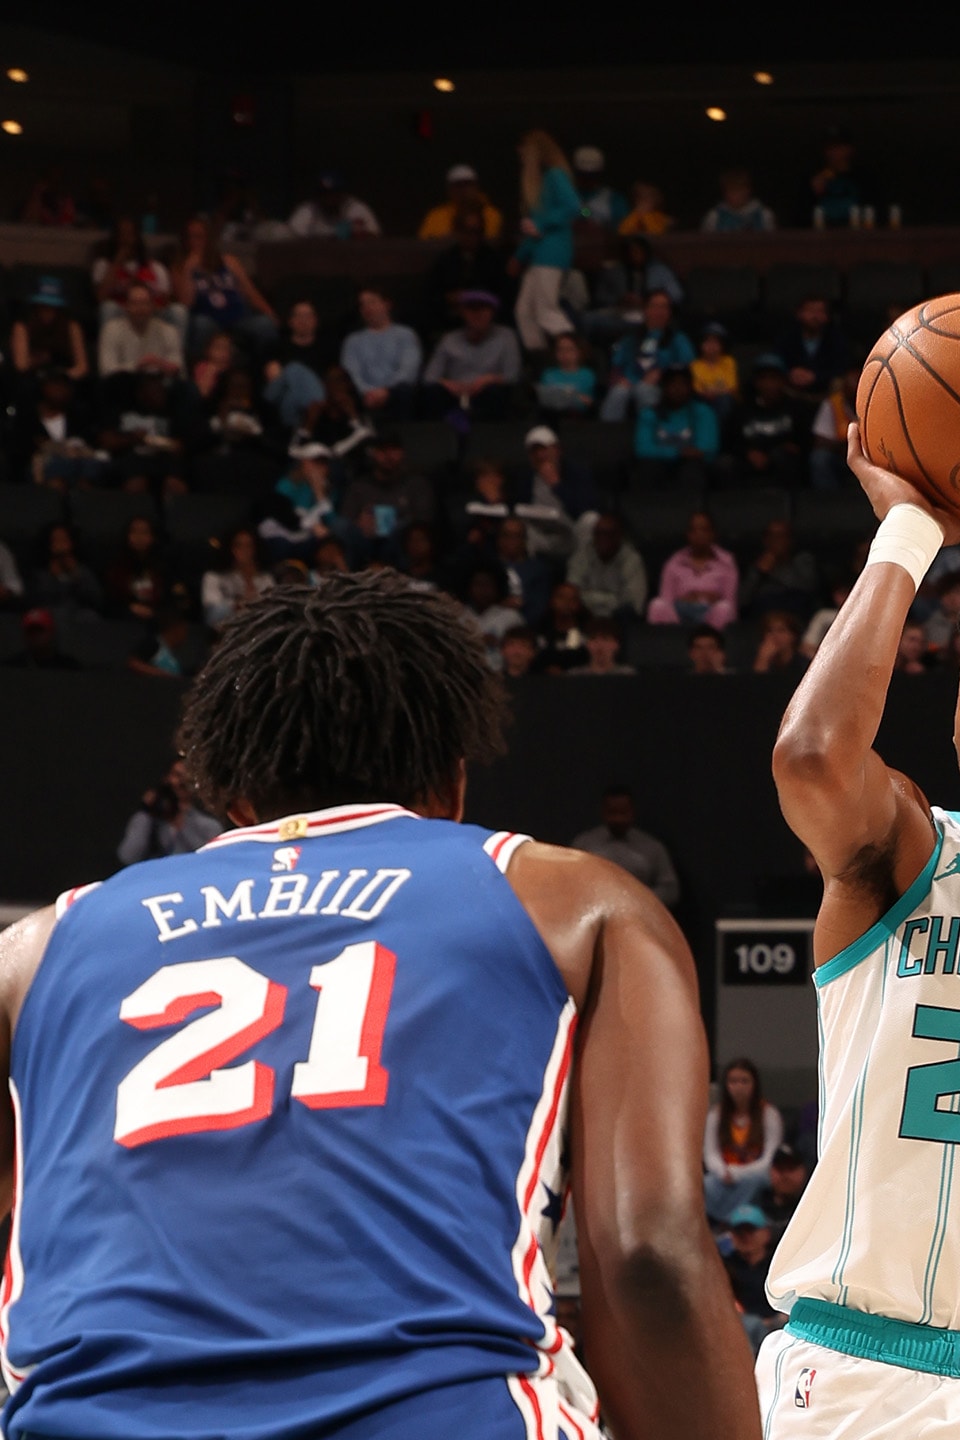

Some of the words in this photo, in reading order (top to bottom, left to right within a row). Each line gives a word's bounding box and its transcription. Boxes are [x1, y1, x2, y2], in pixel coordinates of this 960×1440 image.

[141, 868, 412, 942] EMBIID
[735, 943, 795, 974] 109
[114, 940, 397, 1149] 21
